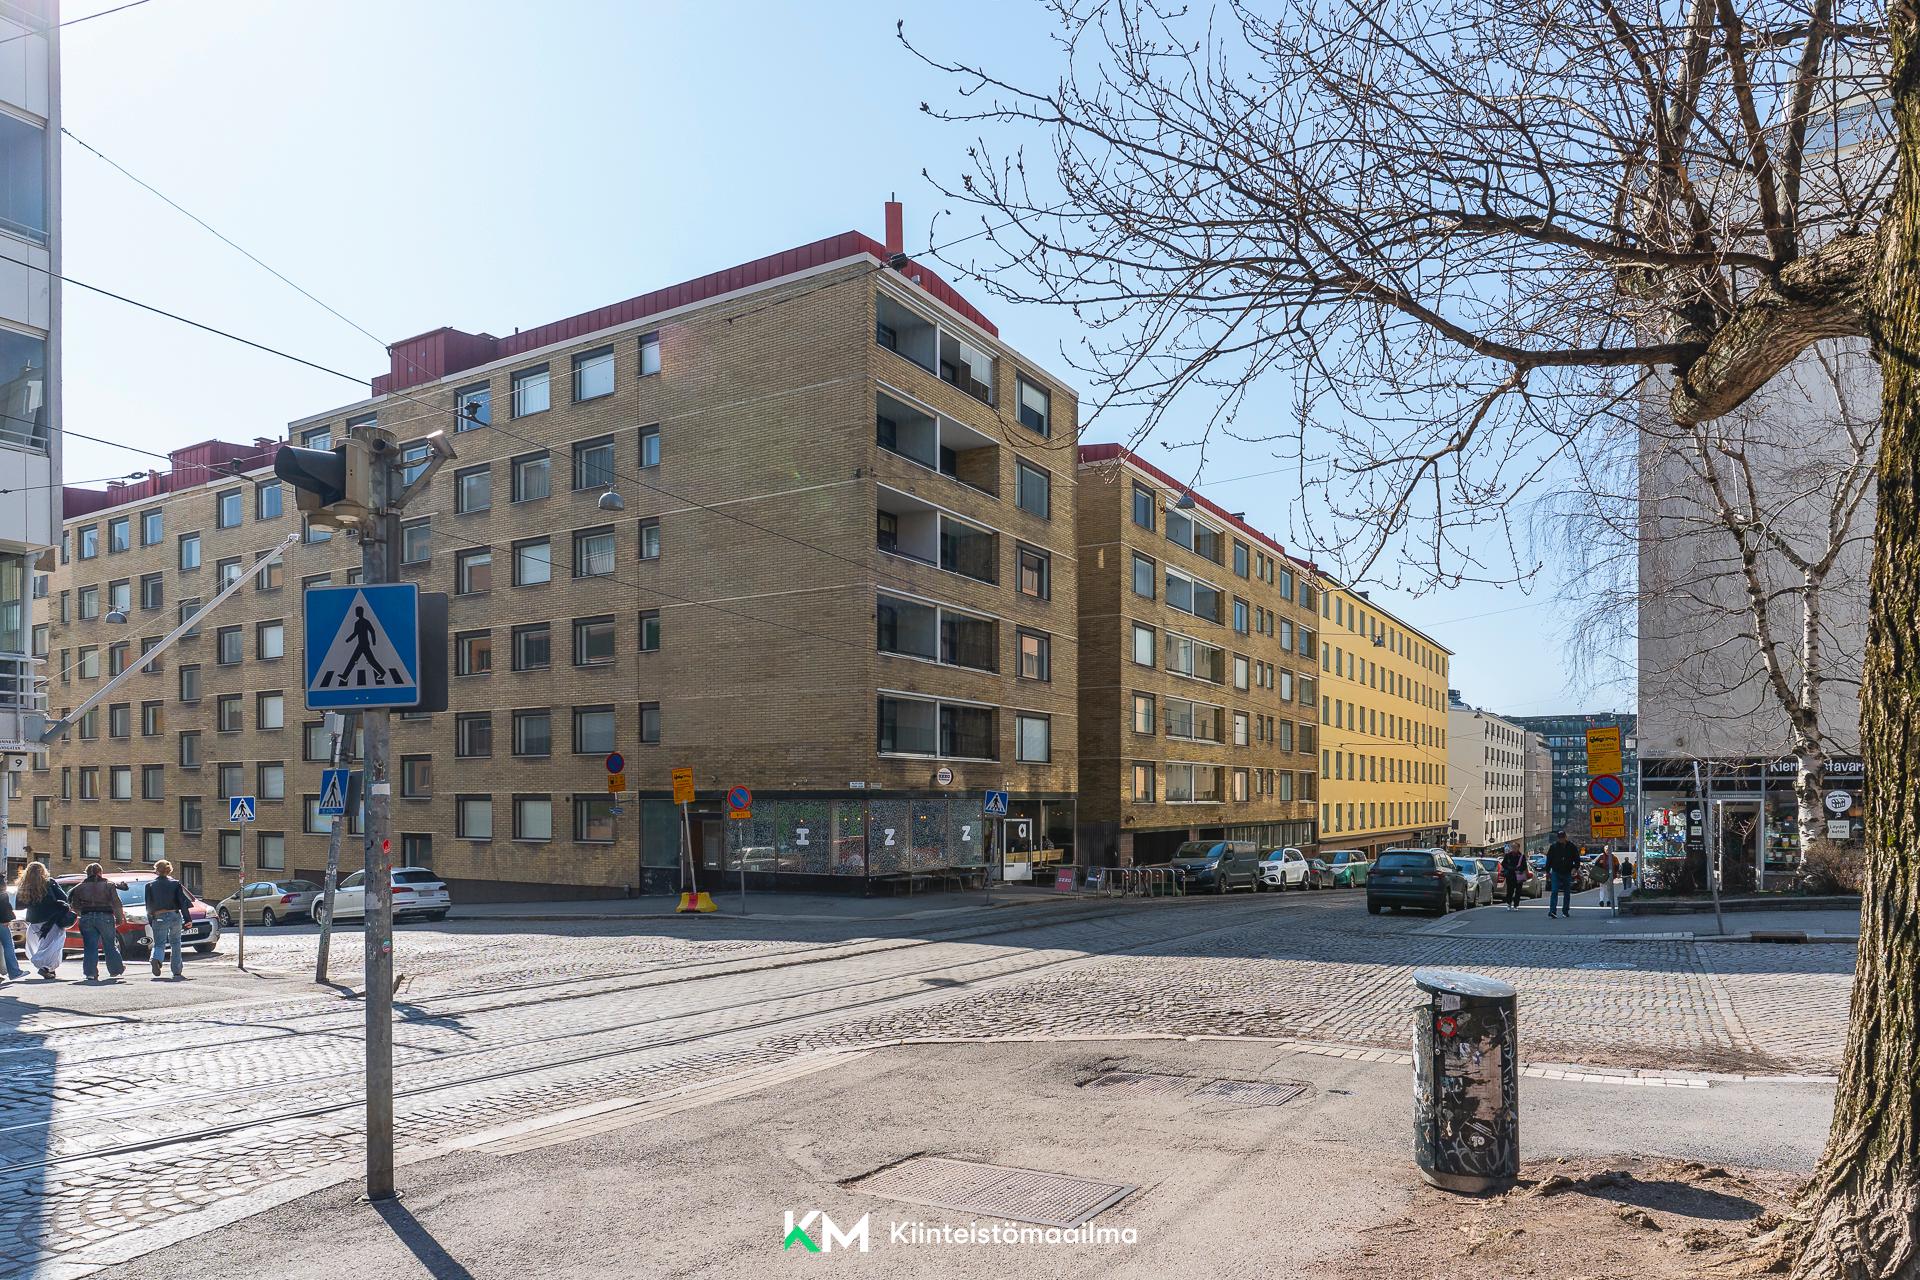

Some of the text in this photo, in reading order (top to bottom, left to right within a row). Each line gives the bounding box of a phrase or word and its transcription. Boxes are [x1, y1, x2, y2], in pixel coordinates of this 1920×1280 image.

[15, 758, 23, 767] 9
[796, 828, 810, 846] I
[884, 828, 896, 846] Z
[961, 825, 971, 842] Z
